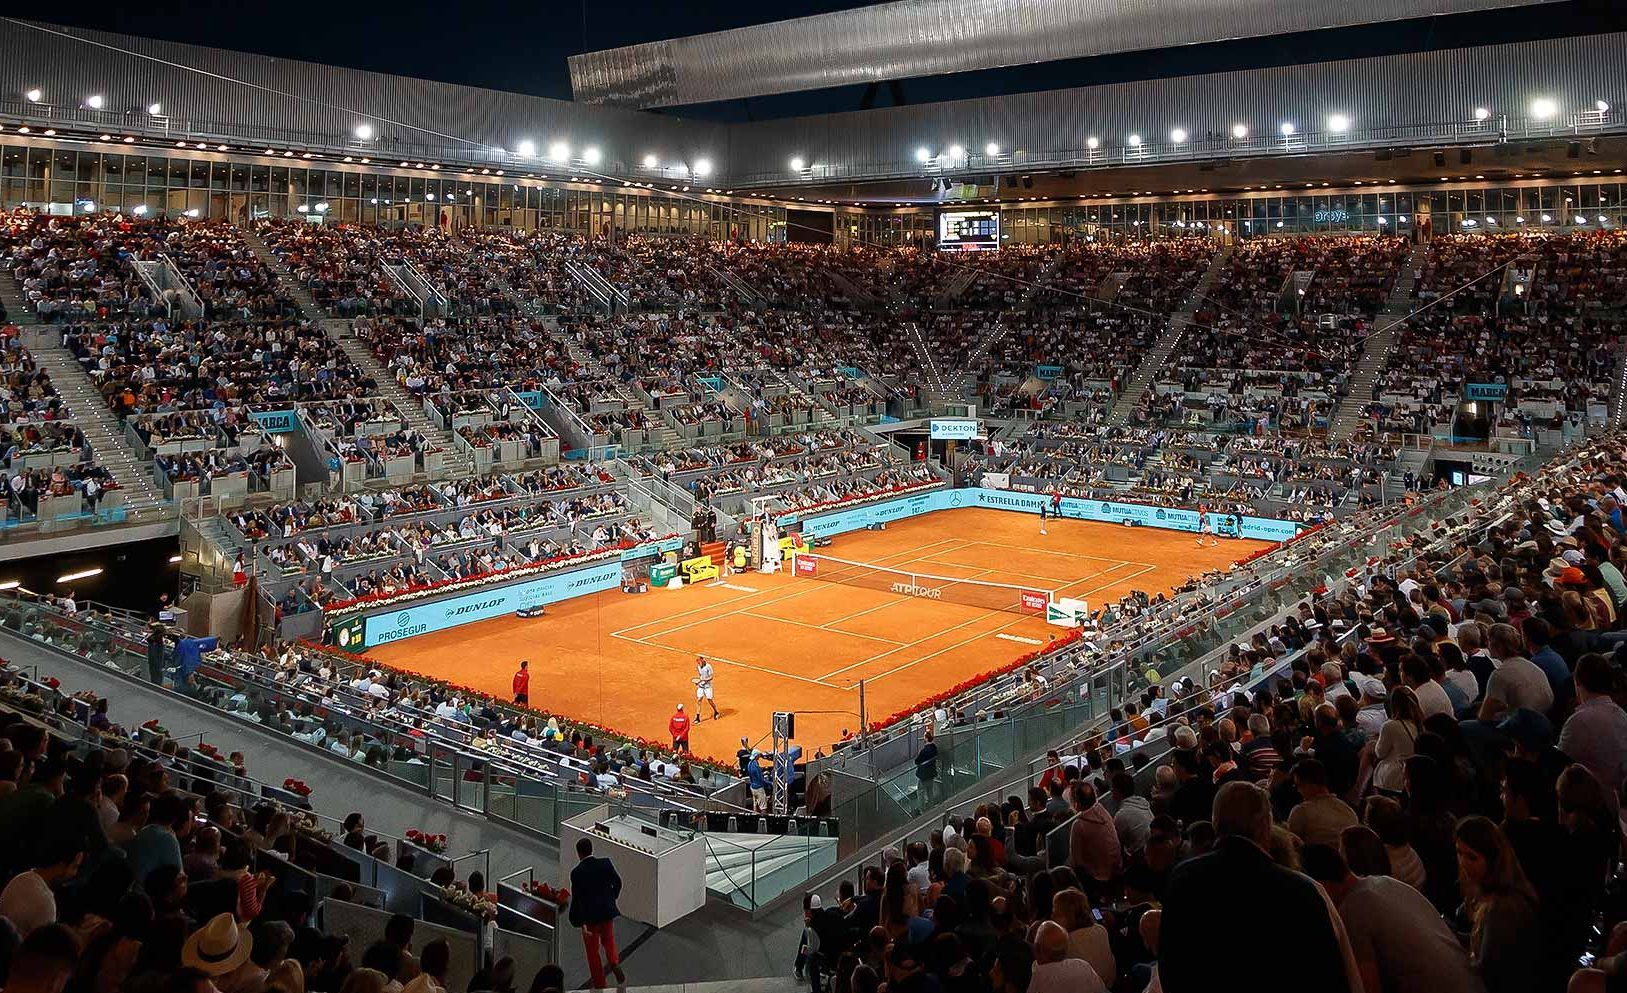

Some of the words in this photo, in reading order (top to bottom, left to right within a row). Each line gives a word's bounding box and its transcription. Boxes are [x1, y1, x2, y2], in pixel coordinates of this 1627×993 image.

[987, 495, 1020, 505] ESTRELLA
[574, 571, 618, 588] DUNLOP
[914, 586, 942, 599] TOUR
[455, 597, 506, 616] DUNLOP
[378, 623, 427, 643] PROSEGUR
